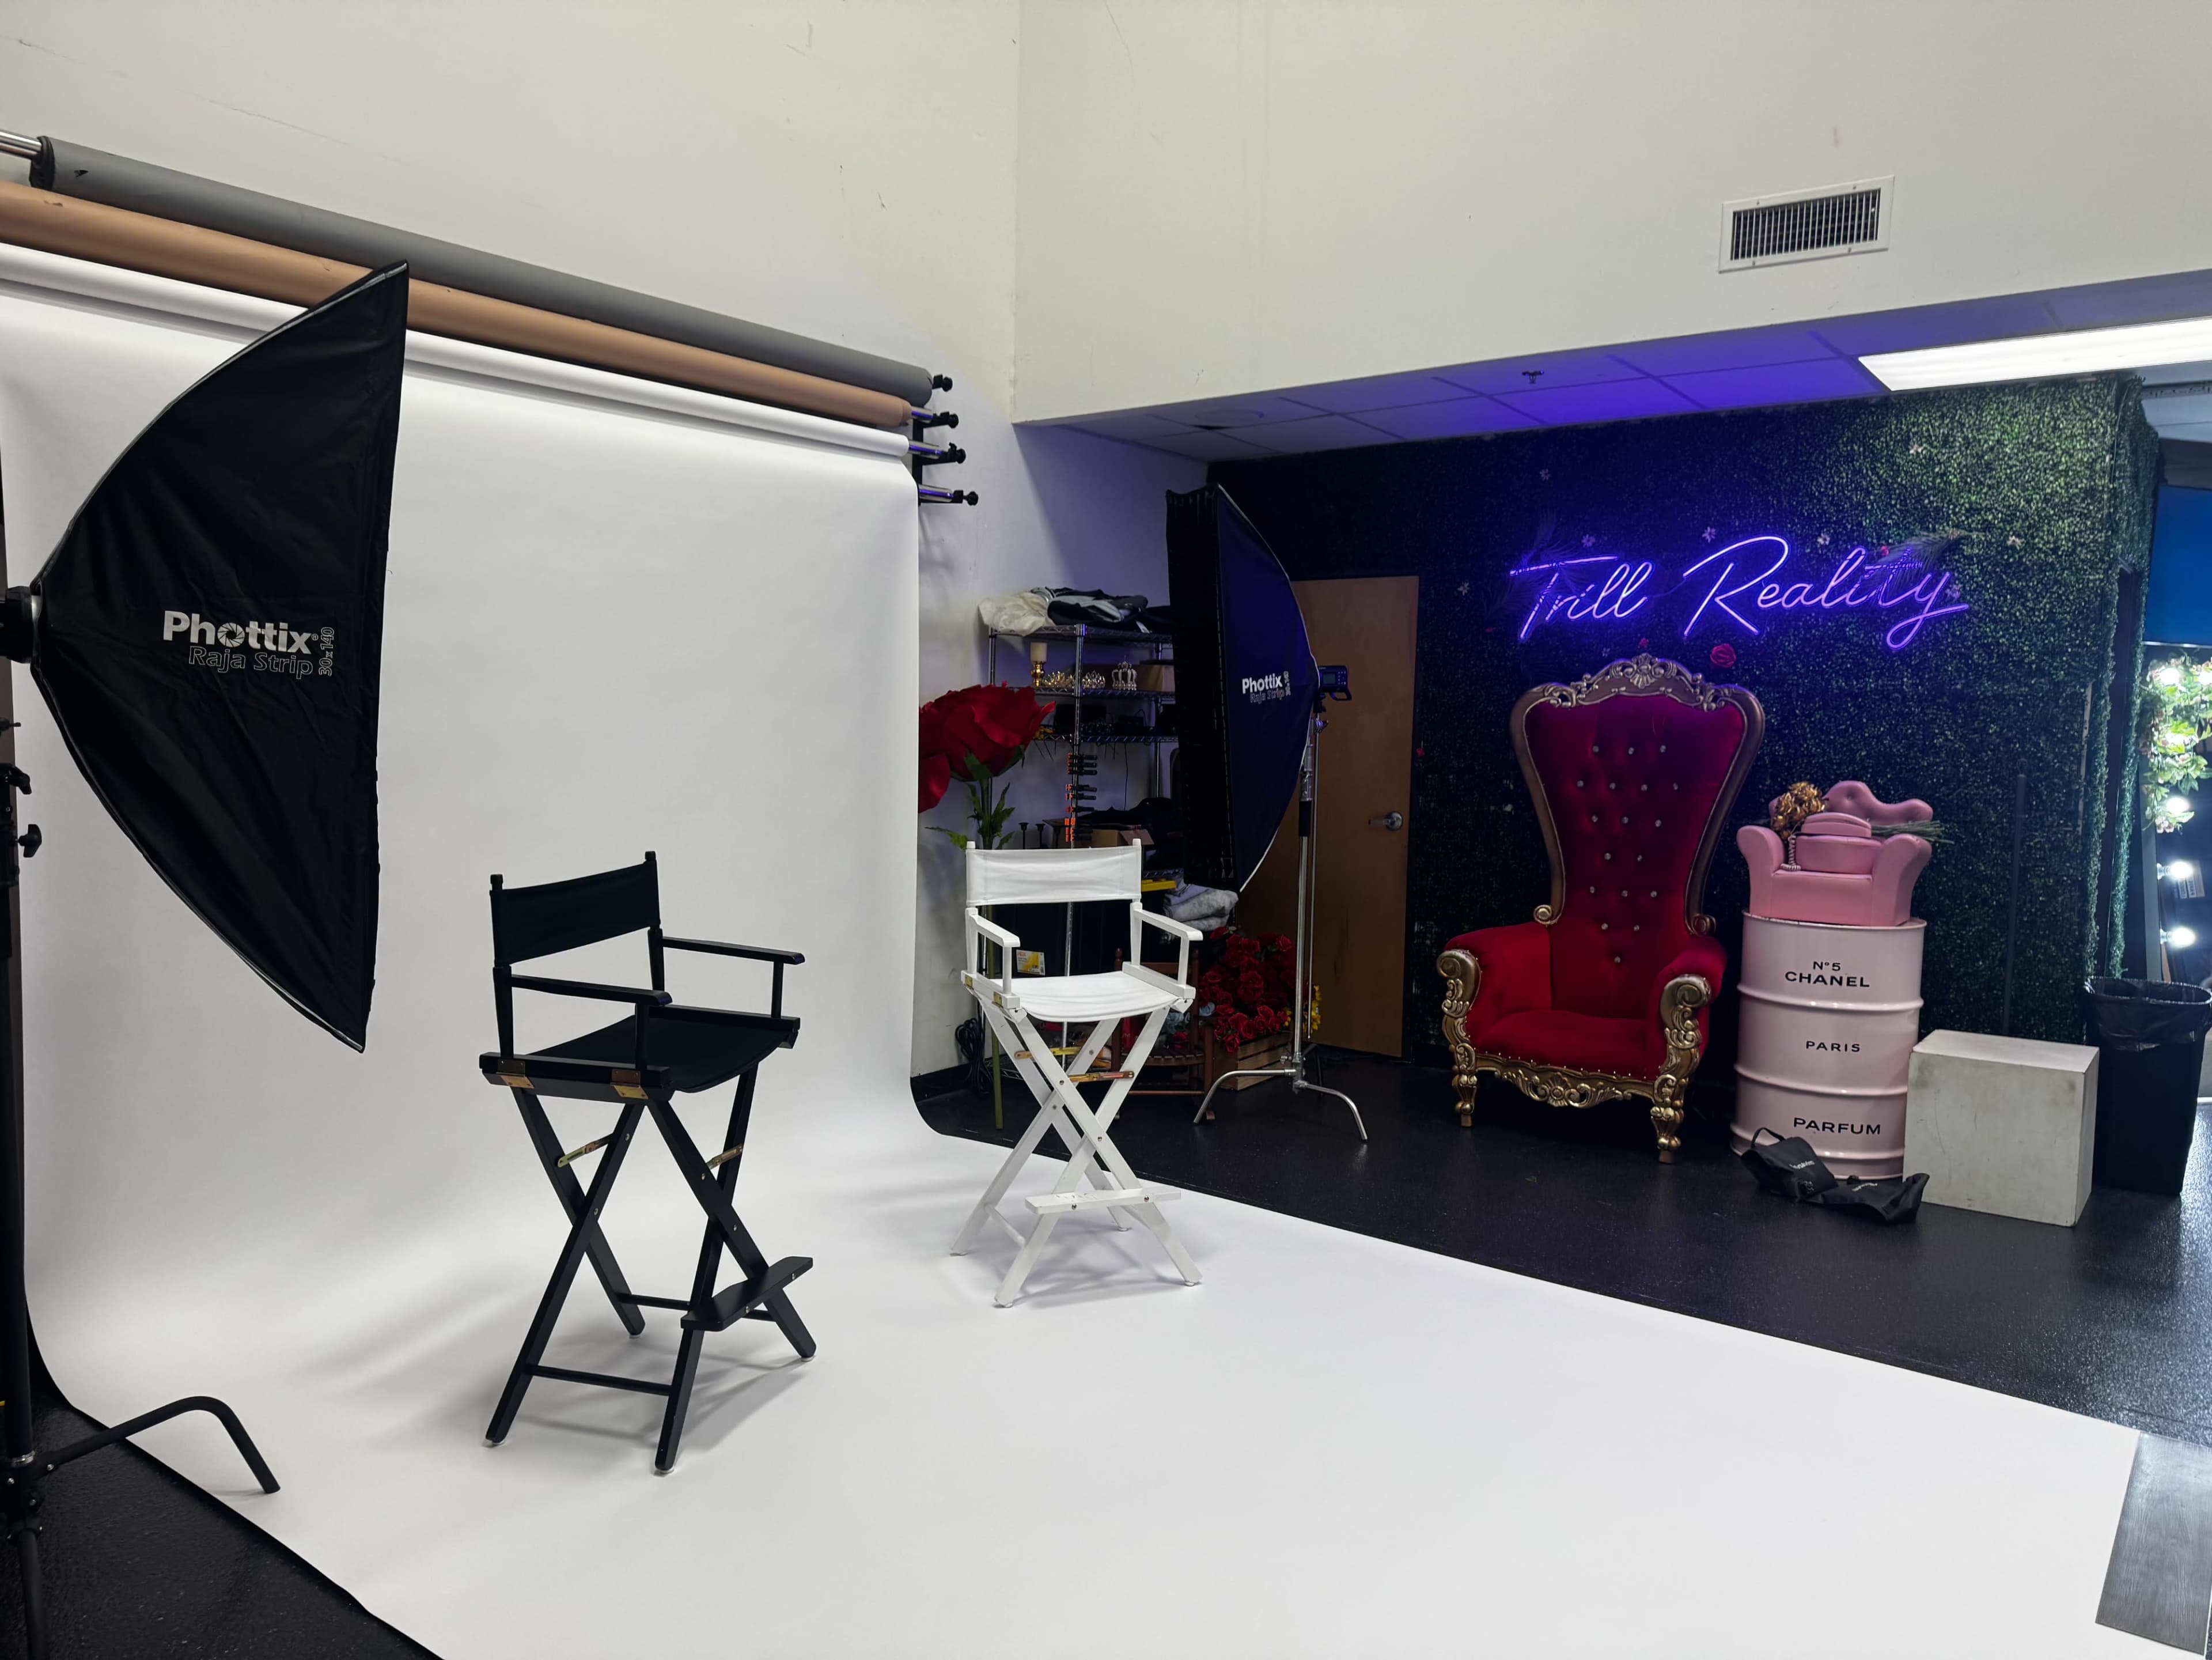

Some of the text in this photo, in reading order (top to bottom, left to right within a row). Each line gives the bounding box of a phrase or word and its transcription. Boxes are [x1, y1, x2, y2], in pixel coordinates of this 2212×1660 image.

[1510, 535, 1969, 650] Trill Reality
[163, 610, 312, 654] Phottix
[188, 645, 313, 679] Raja Strip
[1242, 673, 1283, 694] Phottix
[1785, 971, 1870, 988] CHANEL
[1806, 1041, 1861, 1052] PARIS
[1793, 1117, 1881, 1135] PARFUM
